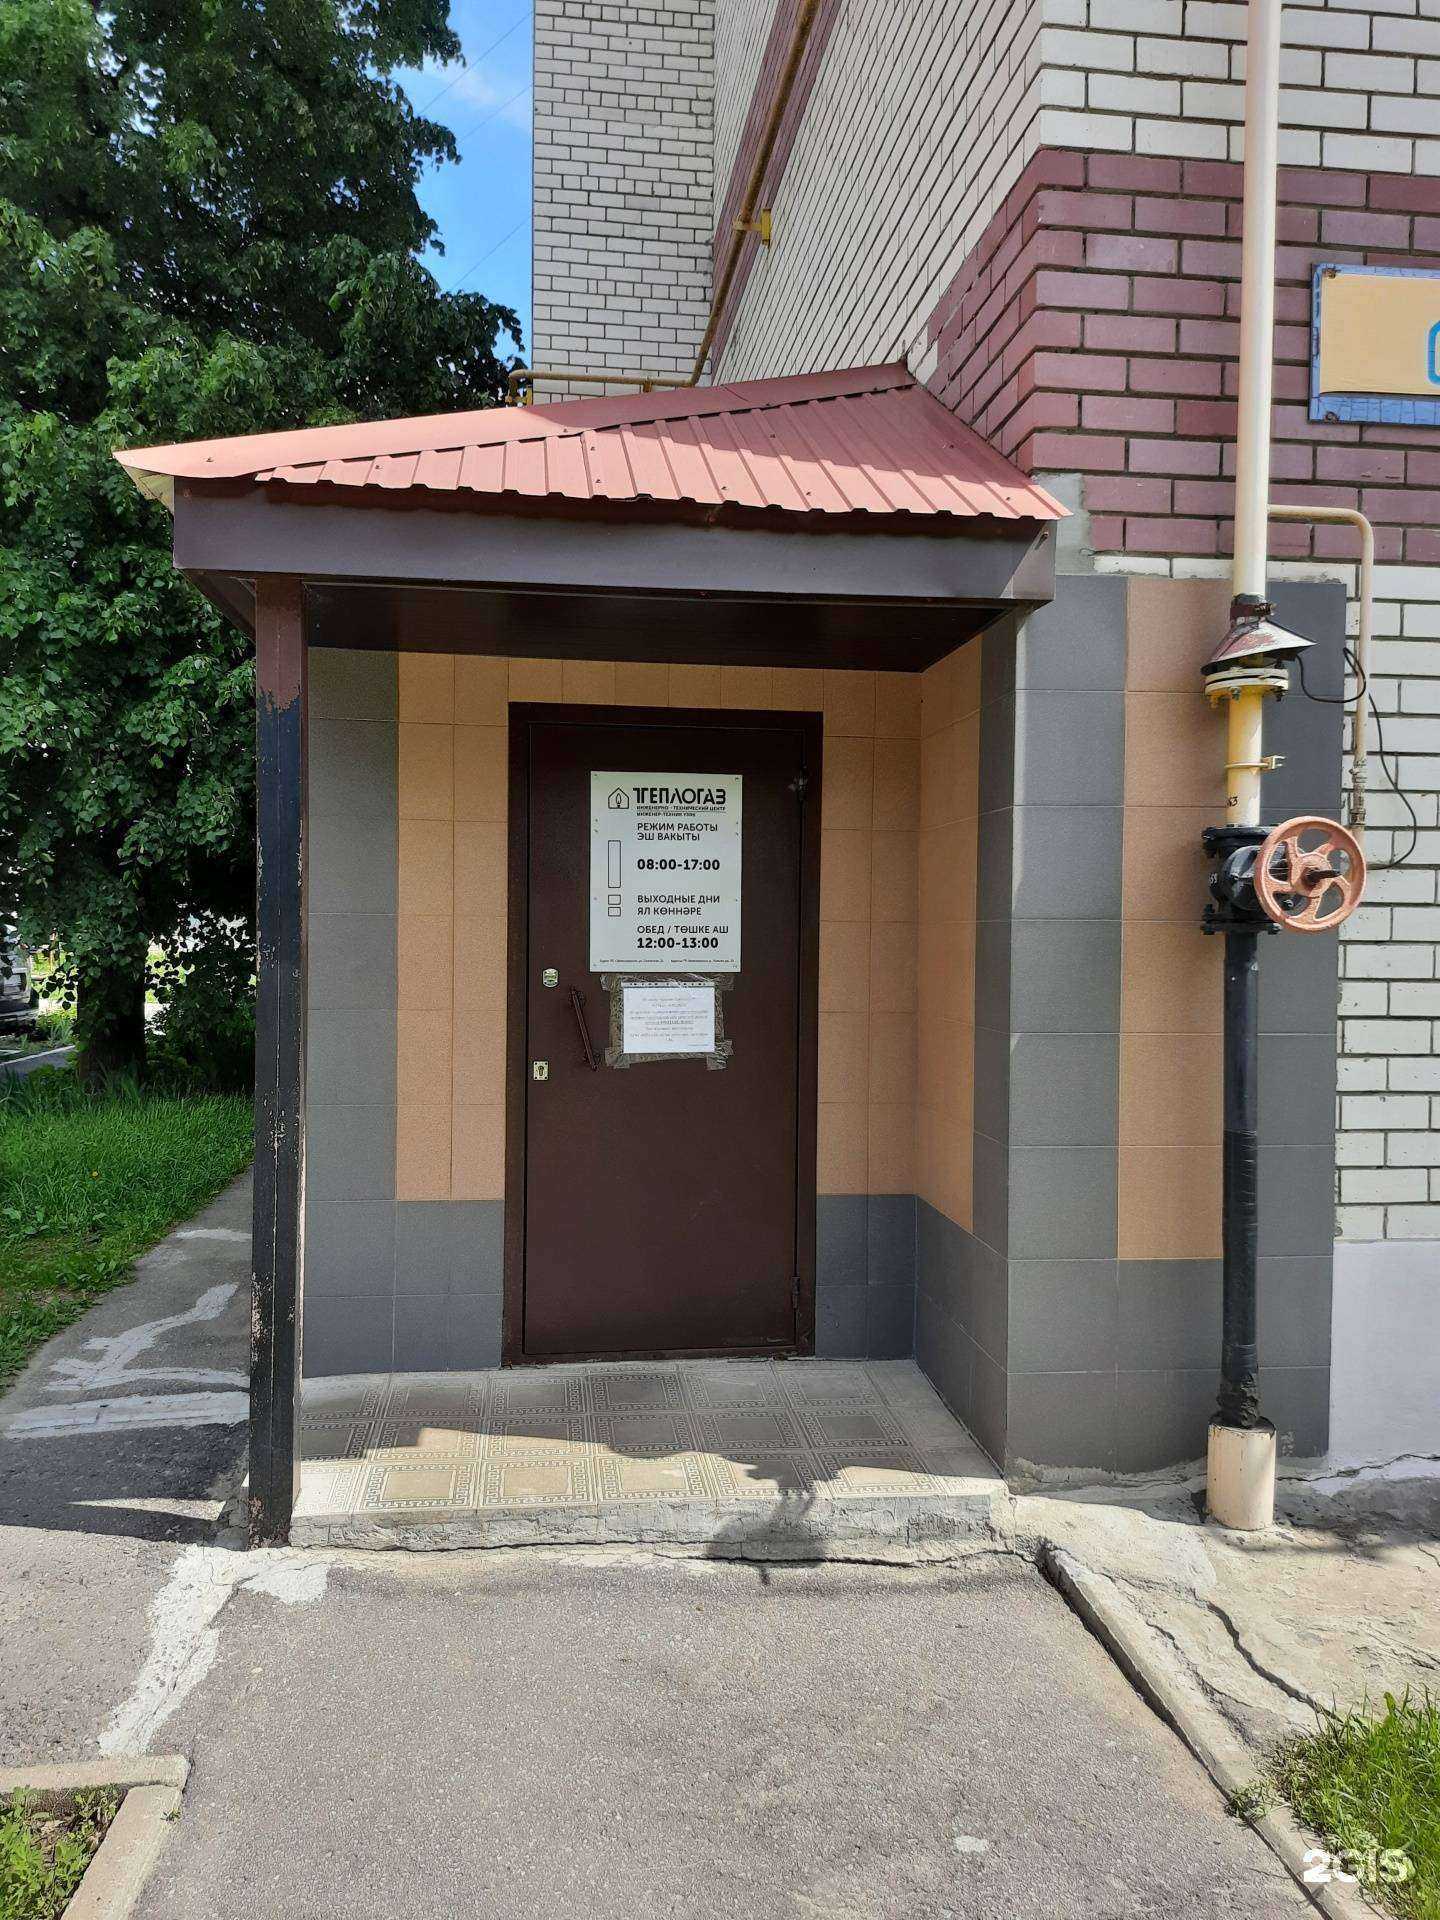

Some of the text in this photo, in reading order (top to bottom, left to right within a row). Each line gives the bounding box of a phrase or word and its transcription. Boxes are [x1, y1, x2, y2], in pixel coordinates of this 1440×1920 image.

[633, 787, 726, 804] ТЕПЛОГАЗ
[637, 823, 718, 831] РЕЖИМ РАБОТЫ
[637, 859, 720, 870] 08:00-17:00
[638, 895, 720, 904] ВЫХОДНЫЕ ДНИ
[637, 907, 701, 915] ЯЛ КӨННӘРЕ
[637, 926, 664, 934] ОБЕД
[637, 938, 718, 948] 12:00-13:00
